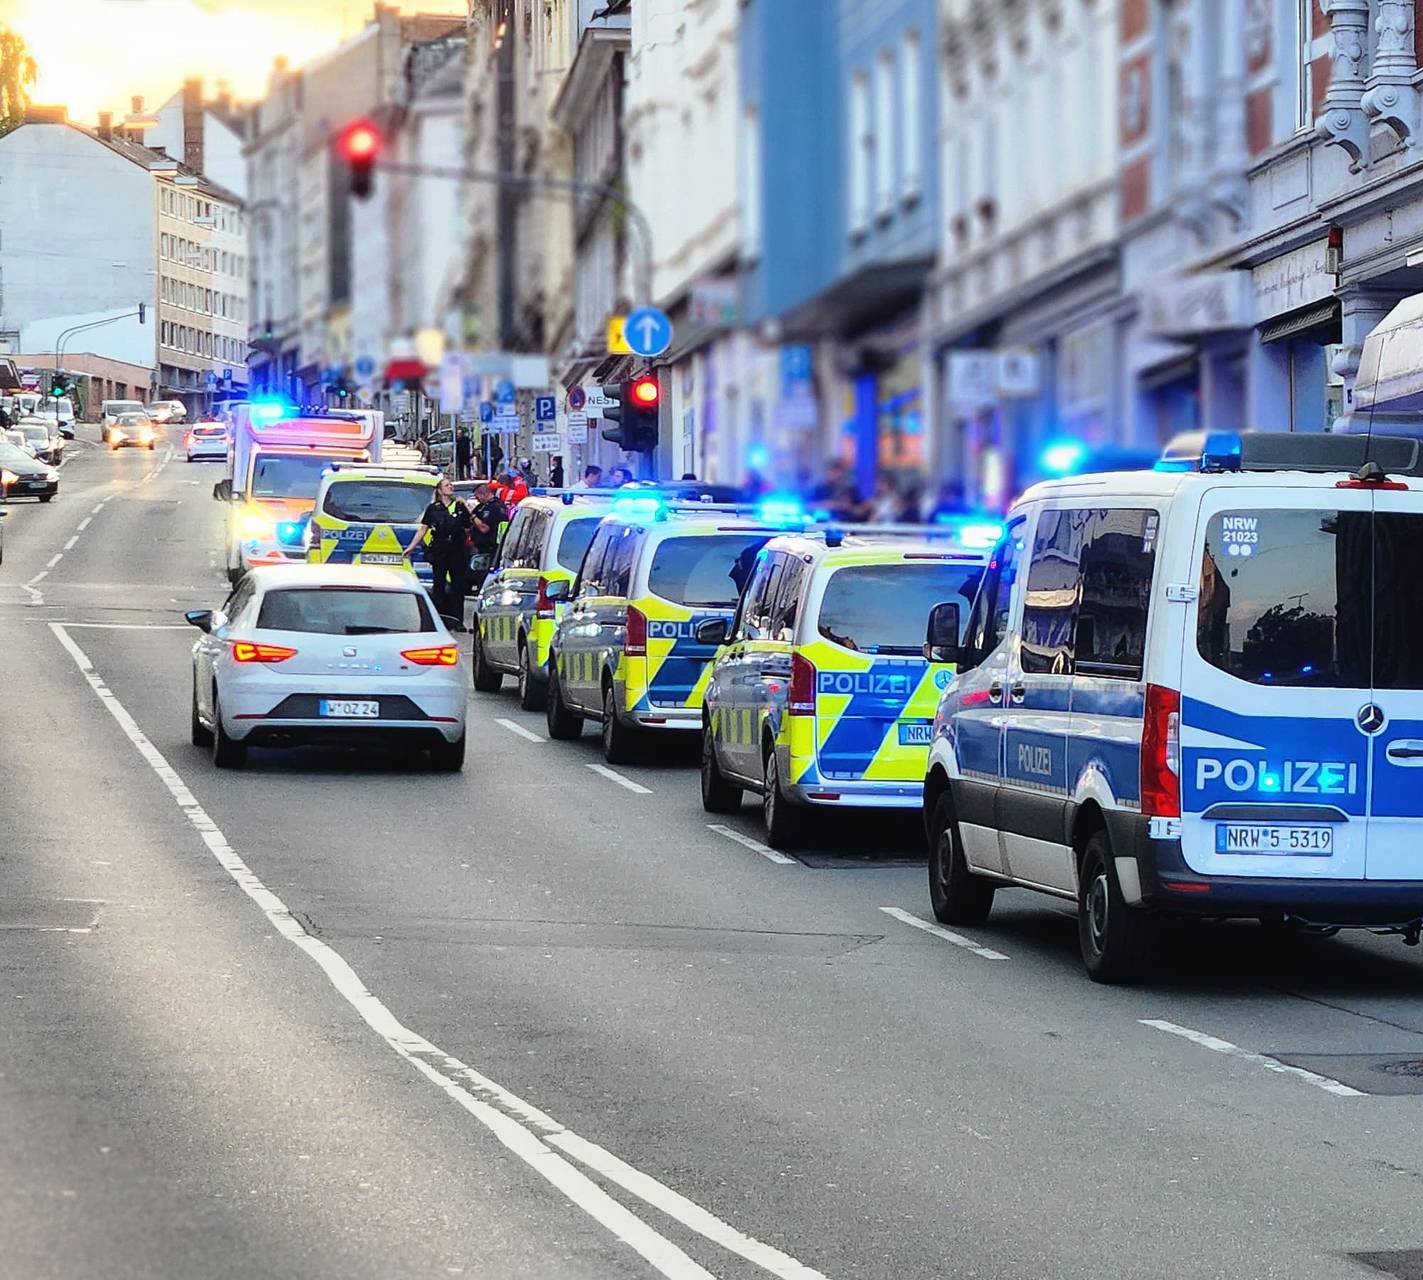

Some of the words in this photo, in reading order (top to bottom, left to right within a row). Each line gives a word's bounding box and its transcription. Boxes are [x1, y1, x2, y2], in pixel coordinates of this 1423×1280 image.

[1223, 517, 1258, 531] NRW
[322, 530, 367, 540] POLIZEI
[1222, 531, 1258, 543] 21023
[649, 621, 698, 638] POLI
[820, 673, 911, 694] POLIZEI
[1018, 744, 1051, 777] POLIZEI
[1197, 758, 1357, 795] POLIZEI
[1228, 828, 1260, 848] NRW
